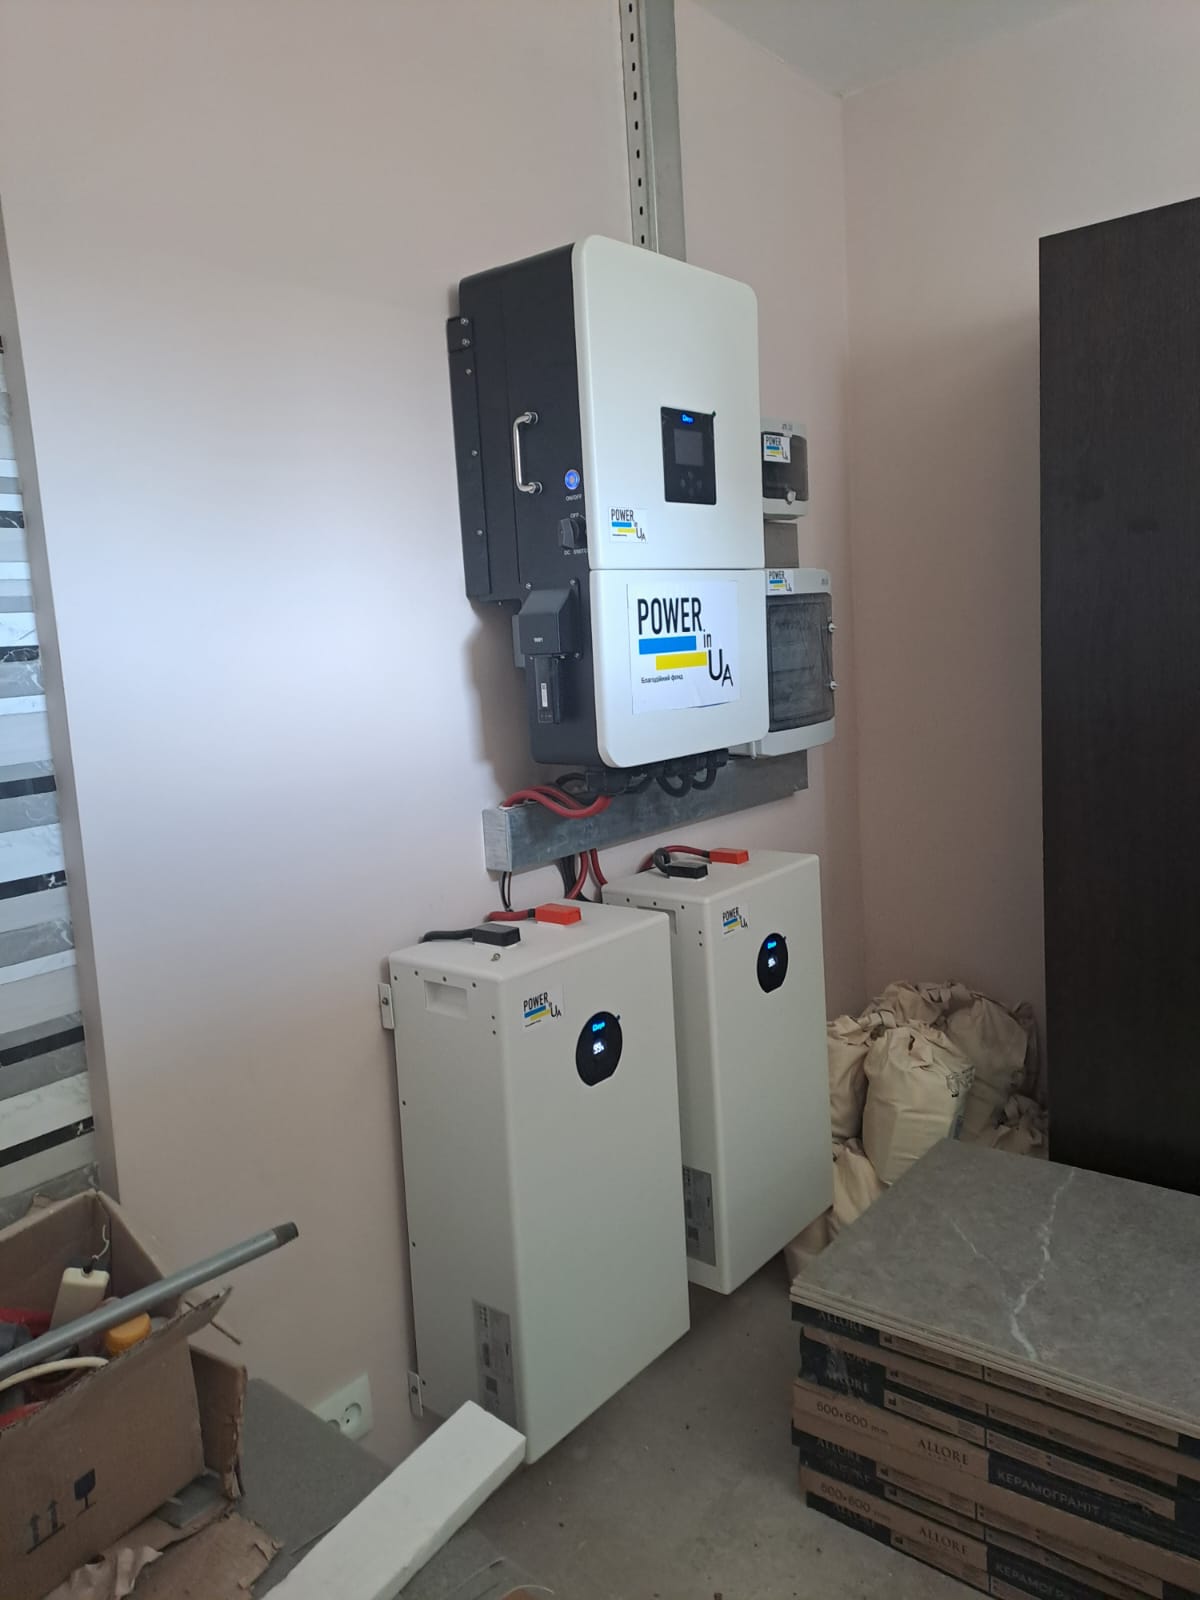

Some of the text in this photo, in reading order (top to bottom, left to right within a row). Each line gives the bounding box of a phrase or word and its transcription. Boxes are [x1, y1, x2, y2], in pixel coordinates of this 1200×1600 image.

[765, 436, 781, 446] POWER
[611, 509, 634, 521] POWER
[636, 528, 647, 541] UA
[768, 571, 784, 579] POWER
[637, 597, 703, 635] POWER
[703, 629, 712, 648] in
[708, 648, 734, 687] UA
[722, 907, 740, 921] POWER
[523, 992, 549, 1012] POWER
[918, 1438, 969, 1466] ALLORE
[918, 1526, 968, 1555] ALLORE
